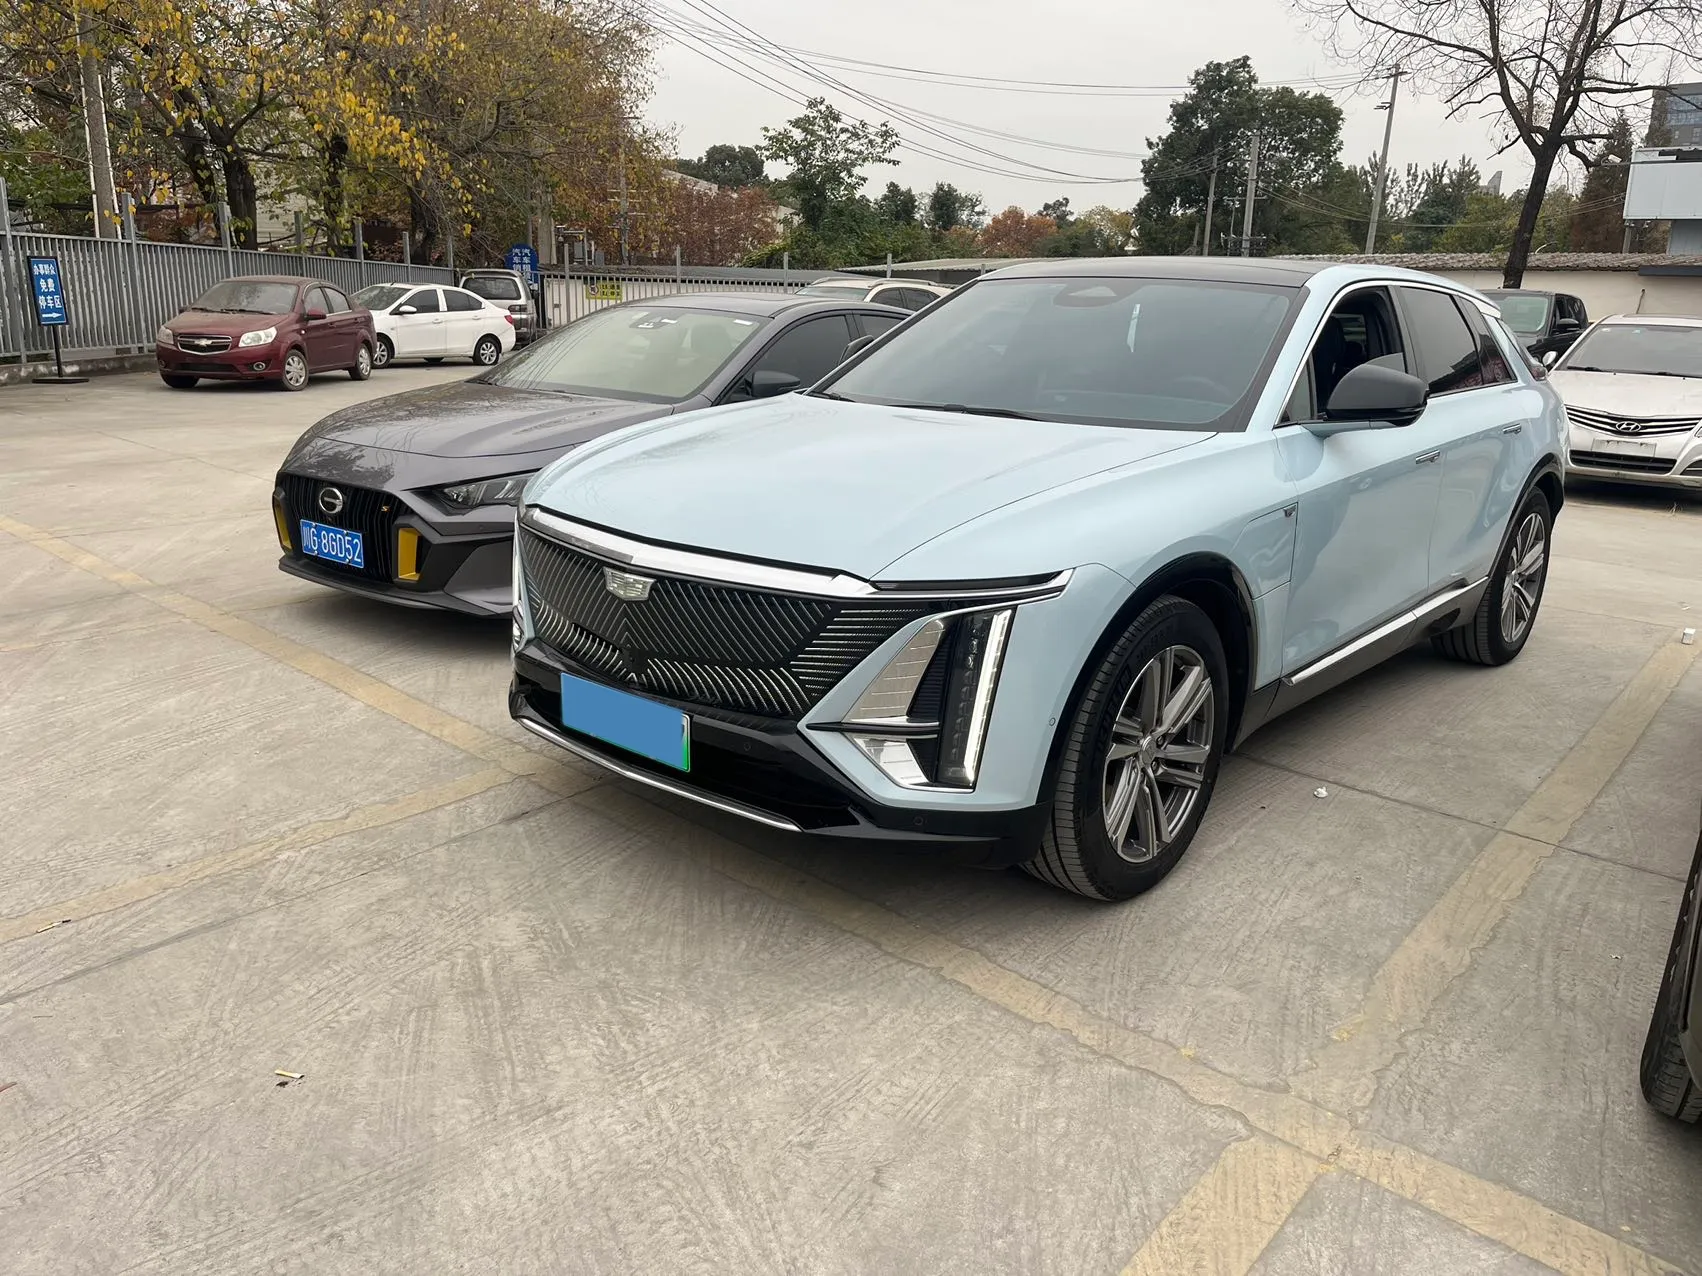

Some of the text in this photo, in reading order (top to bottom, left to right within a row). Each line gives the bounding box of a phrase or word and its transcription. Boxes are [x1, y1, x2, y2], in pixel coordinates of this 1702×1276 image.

[33, 263, 56, 275] 办事群众
[40, 278, 55, 292] 免费
[38, 295, 62, 309] 停车区
